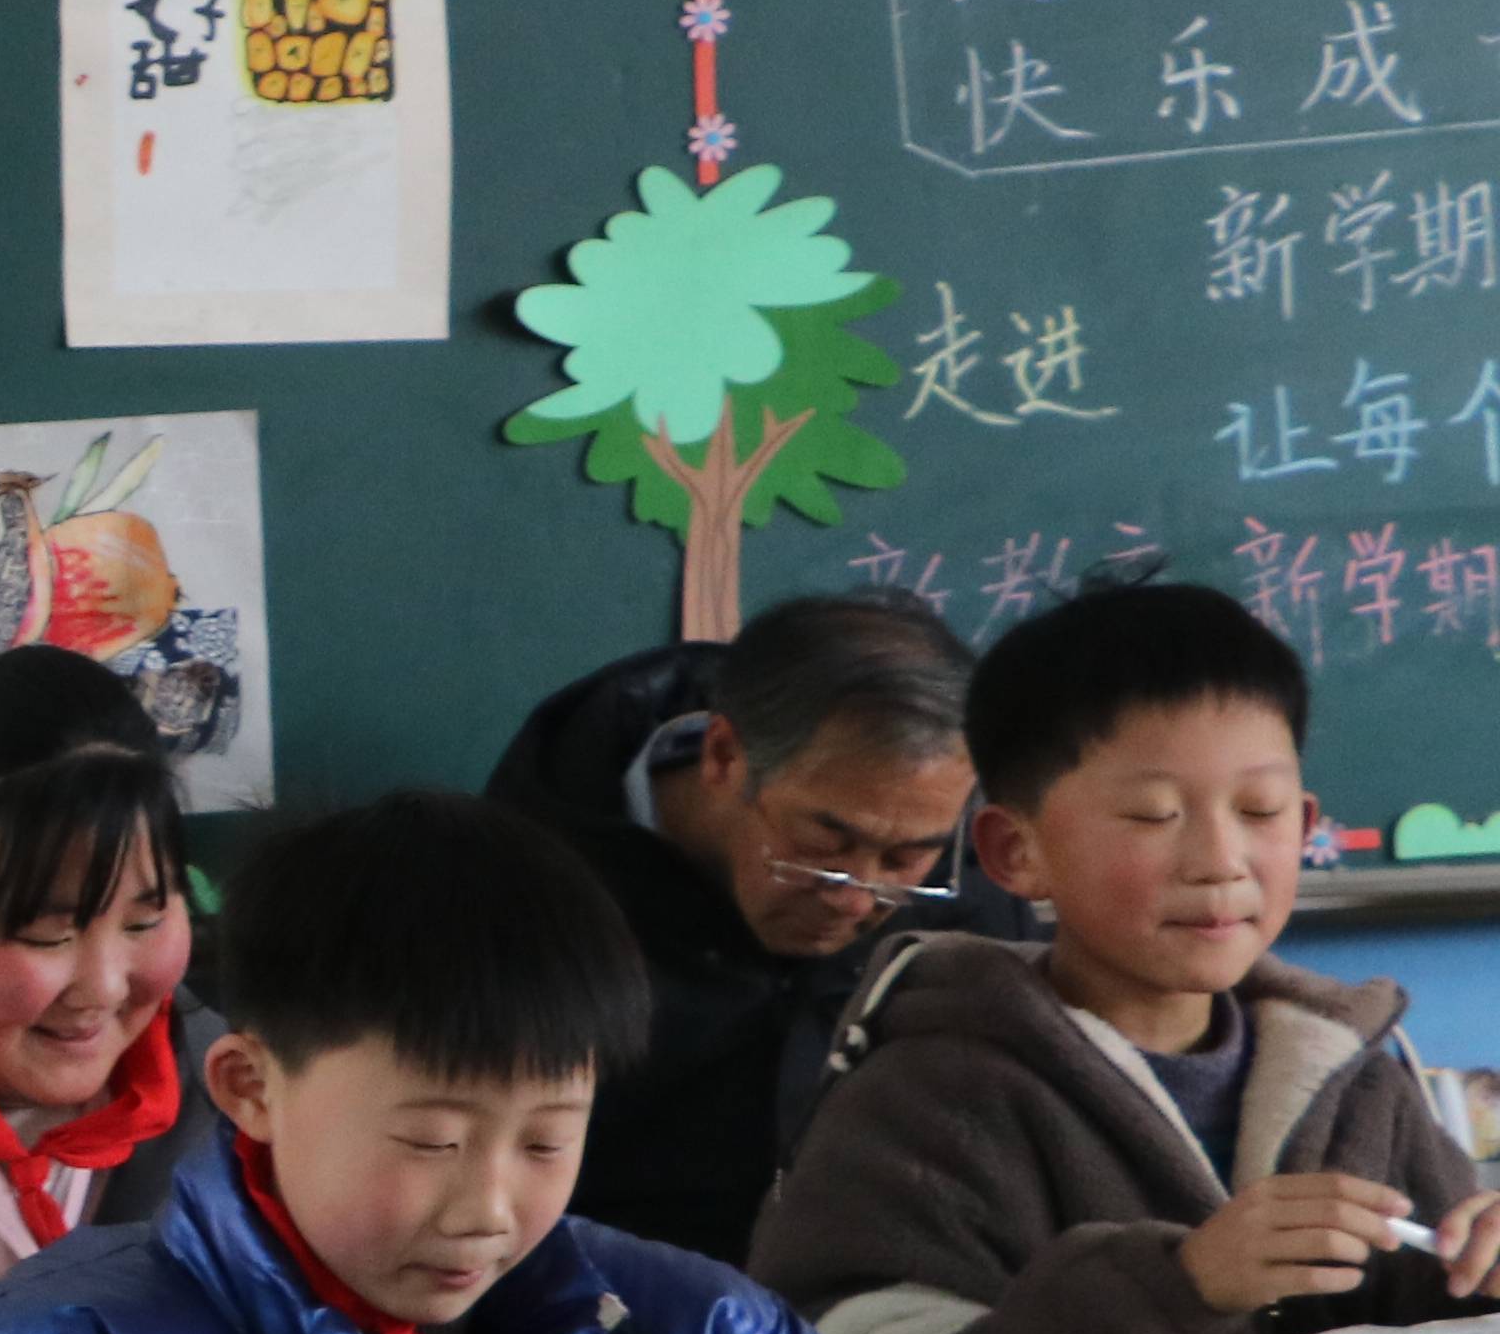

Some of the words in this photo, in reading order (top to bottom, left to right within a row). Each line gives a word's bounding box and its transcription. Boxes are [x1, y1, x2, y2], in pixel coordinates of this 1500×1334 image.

[956, 0, 1500, 154] 快乐成
[1205, 170, 1498, 320] 新学期
[906, 279, 1120, 425] 走进
